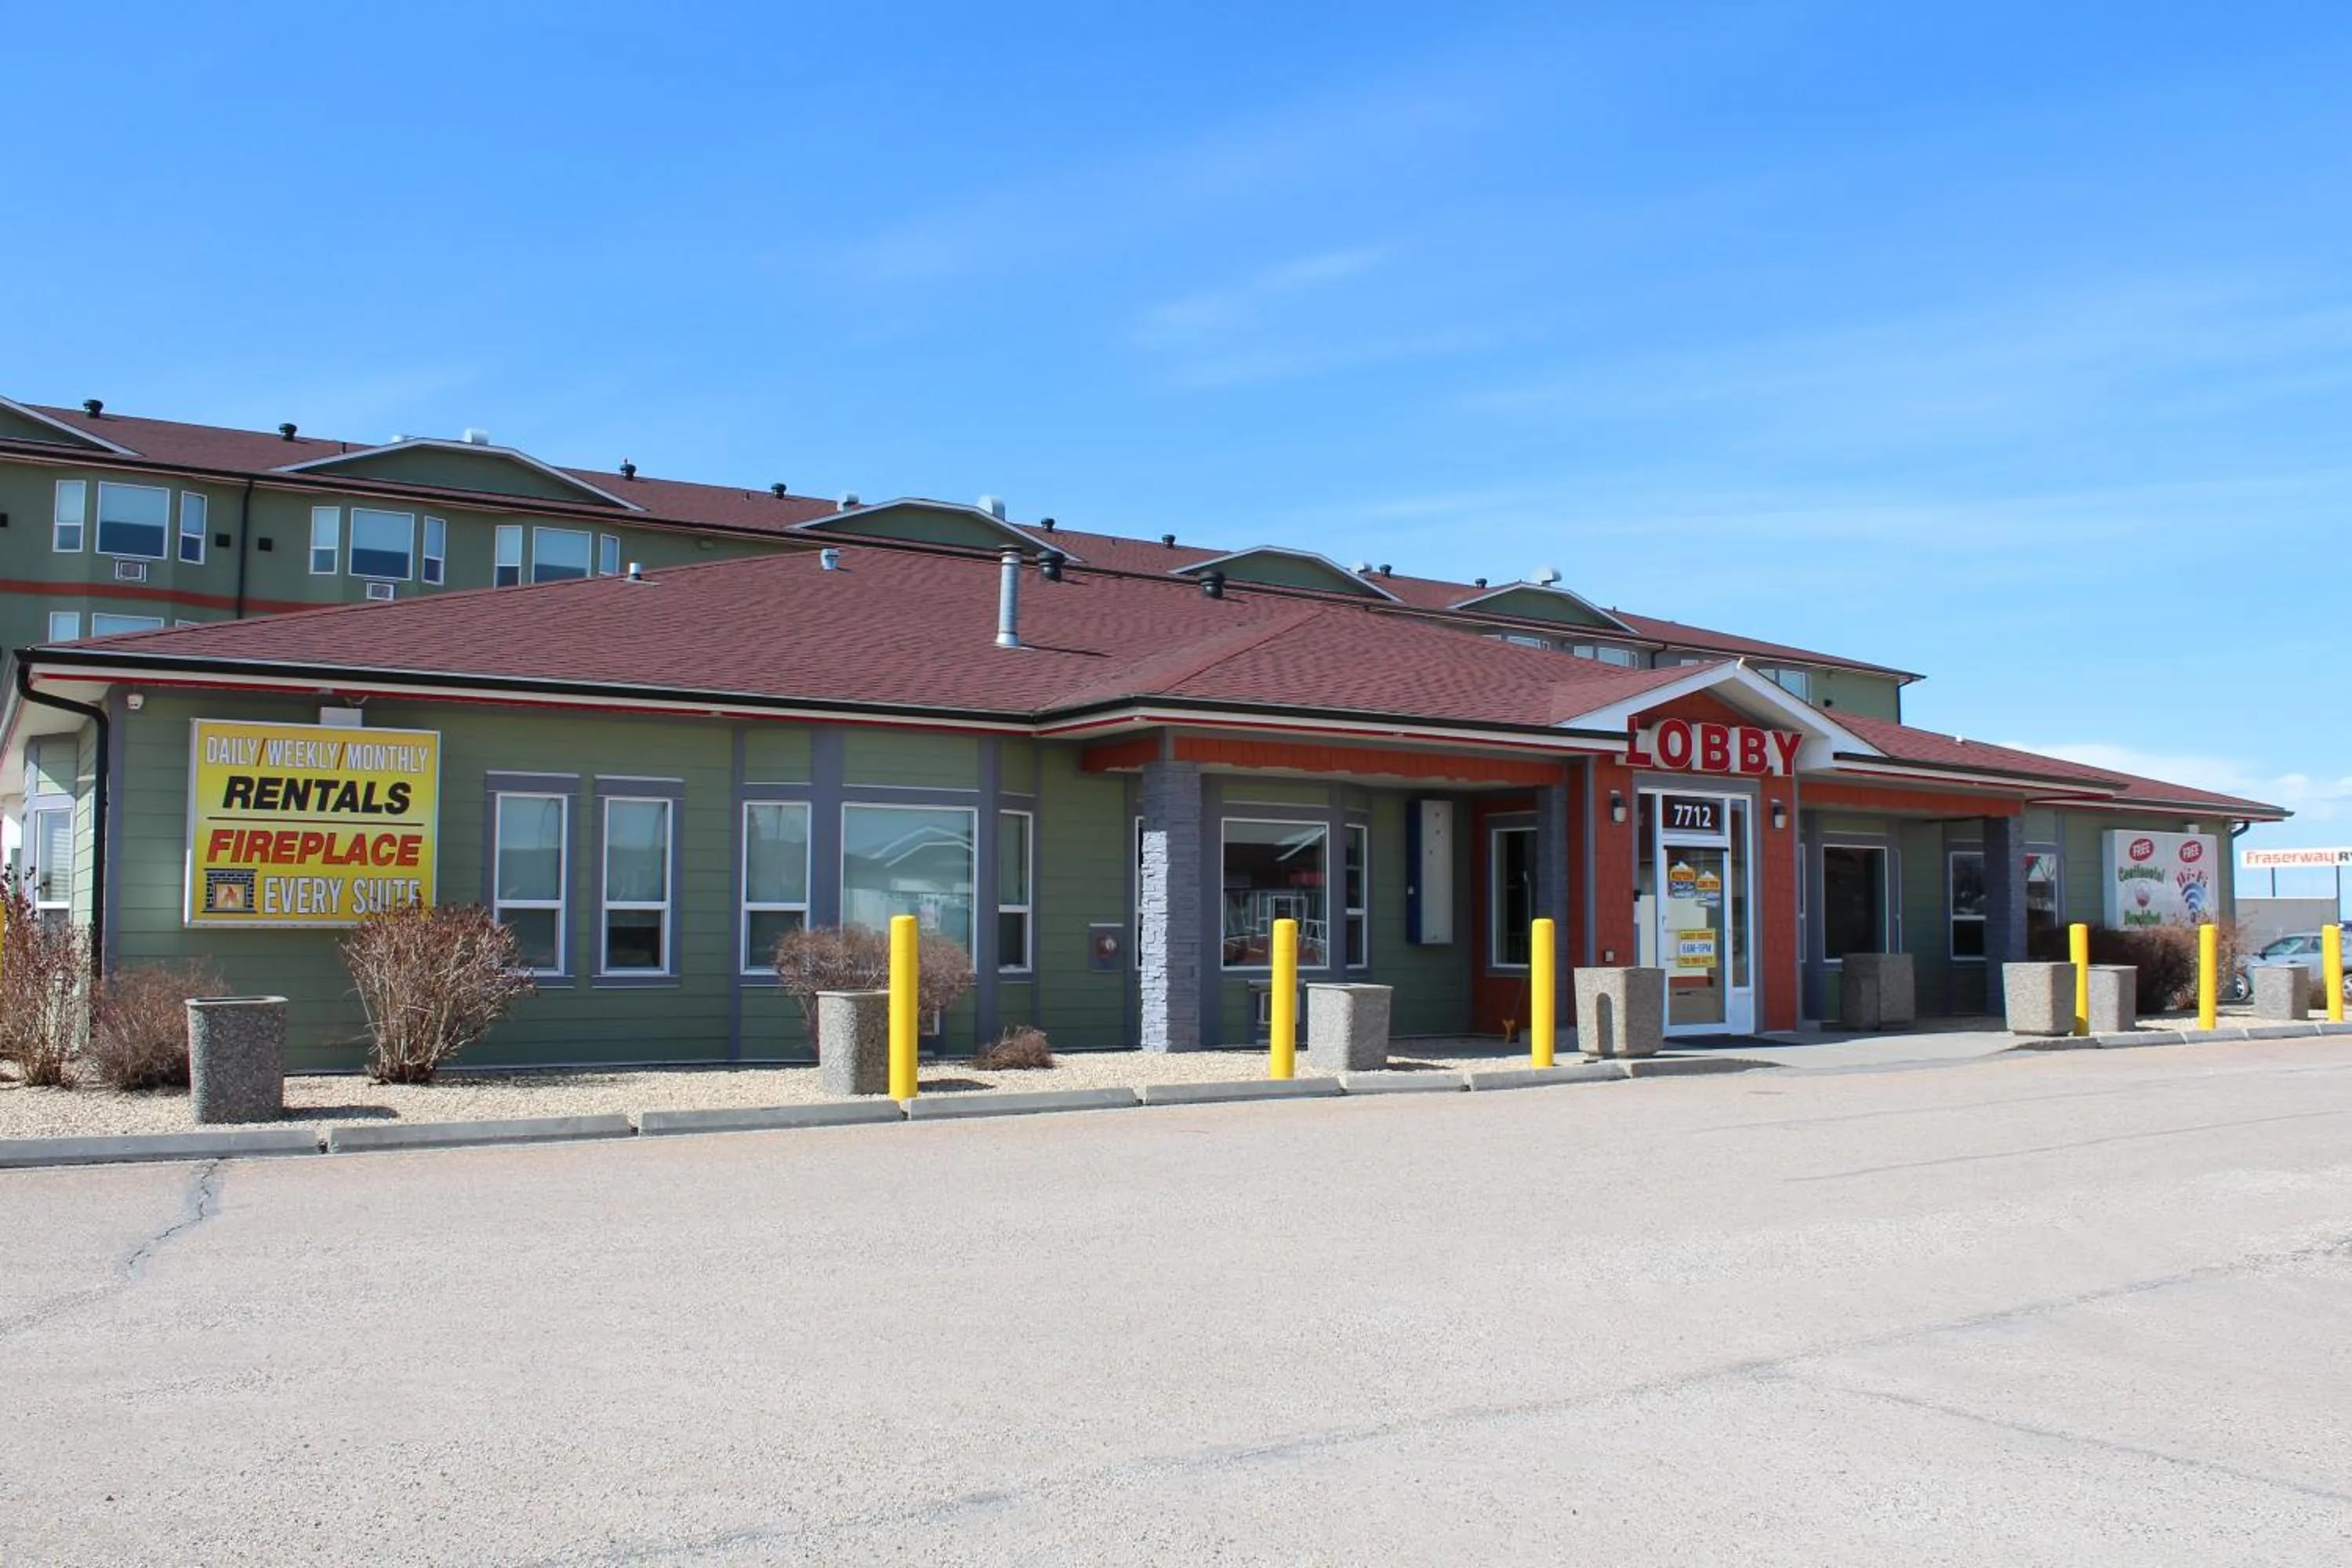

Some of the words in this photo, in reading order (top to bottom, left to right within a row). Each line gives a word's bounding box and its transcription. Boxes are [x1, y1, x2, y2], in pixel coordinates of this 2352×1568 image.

[1624, 715, 1803, 776] LOBBY
[222, 775, 412, 815] RENTALS
[1673, 804, 1711, 827] 7712
[206, 829, 423, 866] FIREPLACE
[2245, 851, 2335, 864] Fraserway
[2339, 851, 2352, 862] R
[263, 877, 345, 914] EVERY
